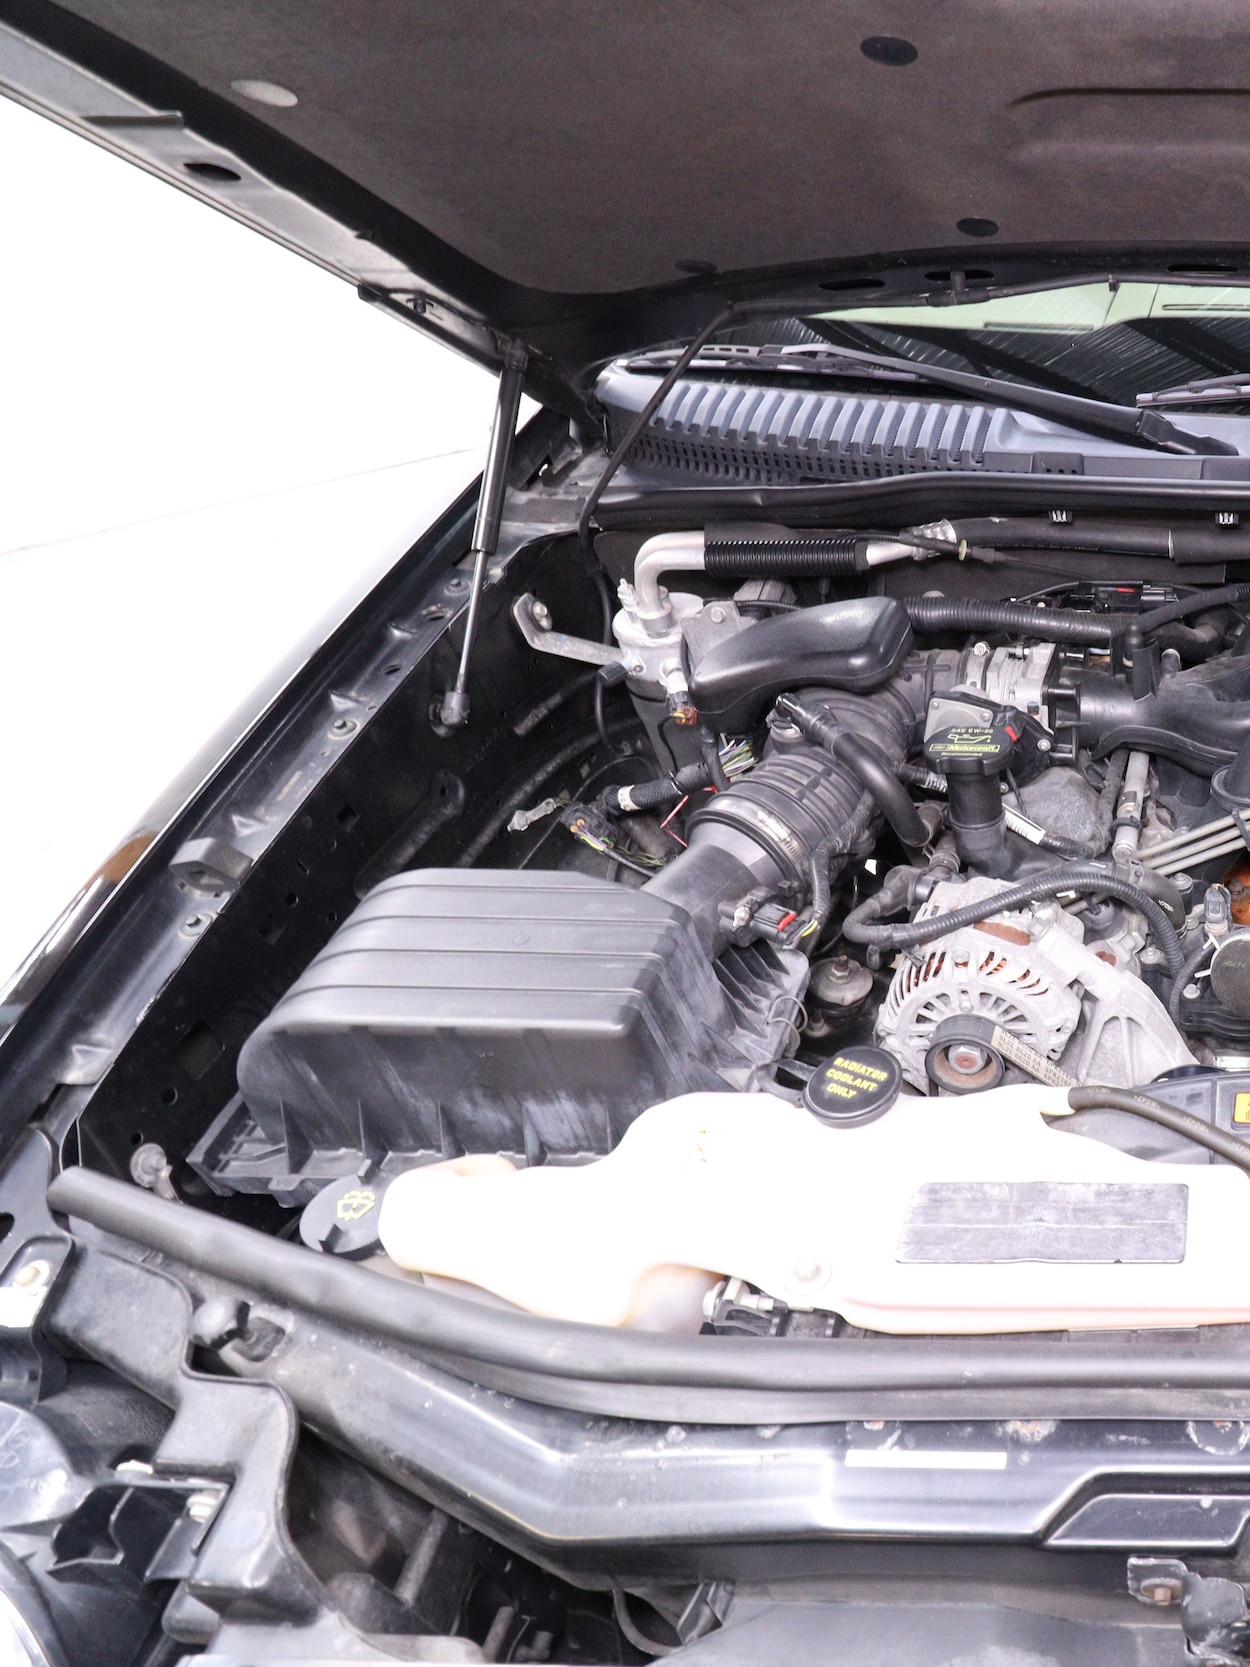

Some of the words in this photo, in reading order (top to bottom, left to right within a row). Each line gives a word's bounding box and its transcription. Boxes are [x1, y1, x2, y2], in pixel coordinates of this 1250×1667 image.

[949, 744, 997, 752] Motorcraft
[833, 1057, 889, 1082] RADIATOR
[826, 1068, 878, 1092] COOLANT
[827, 1083, 857, 1099] ONLY
